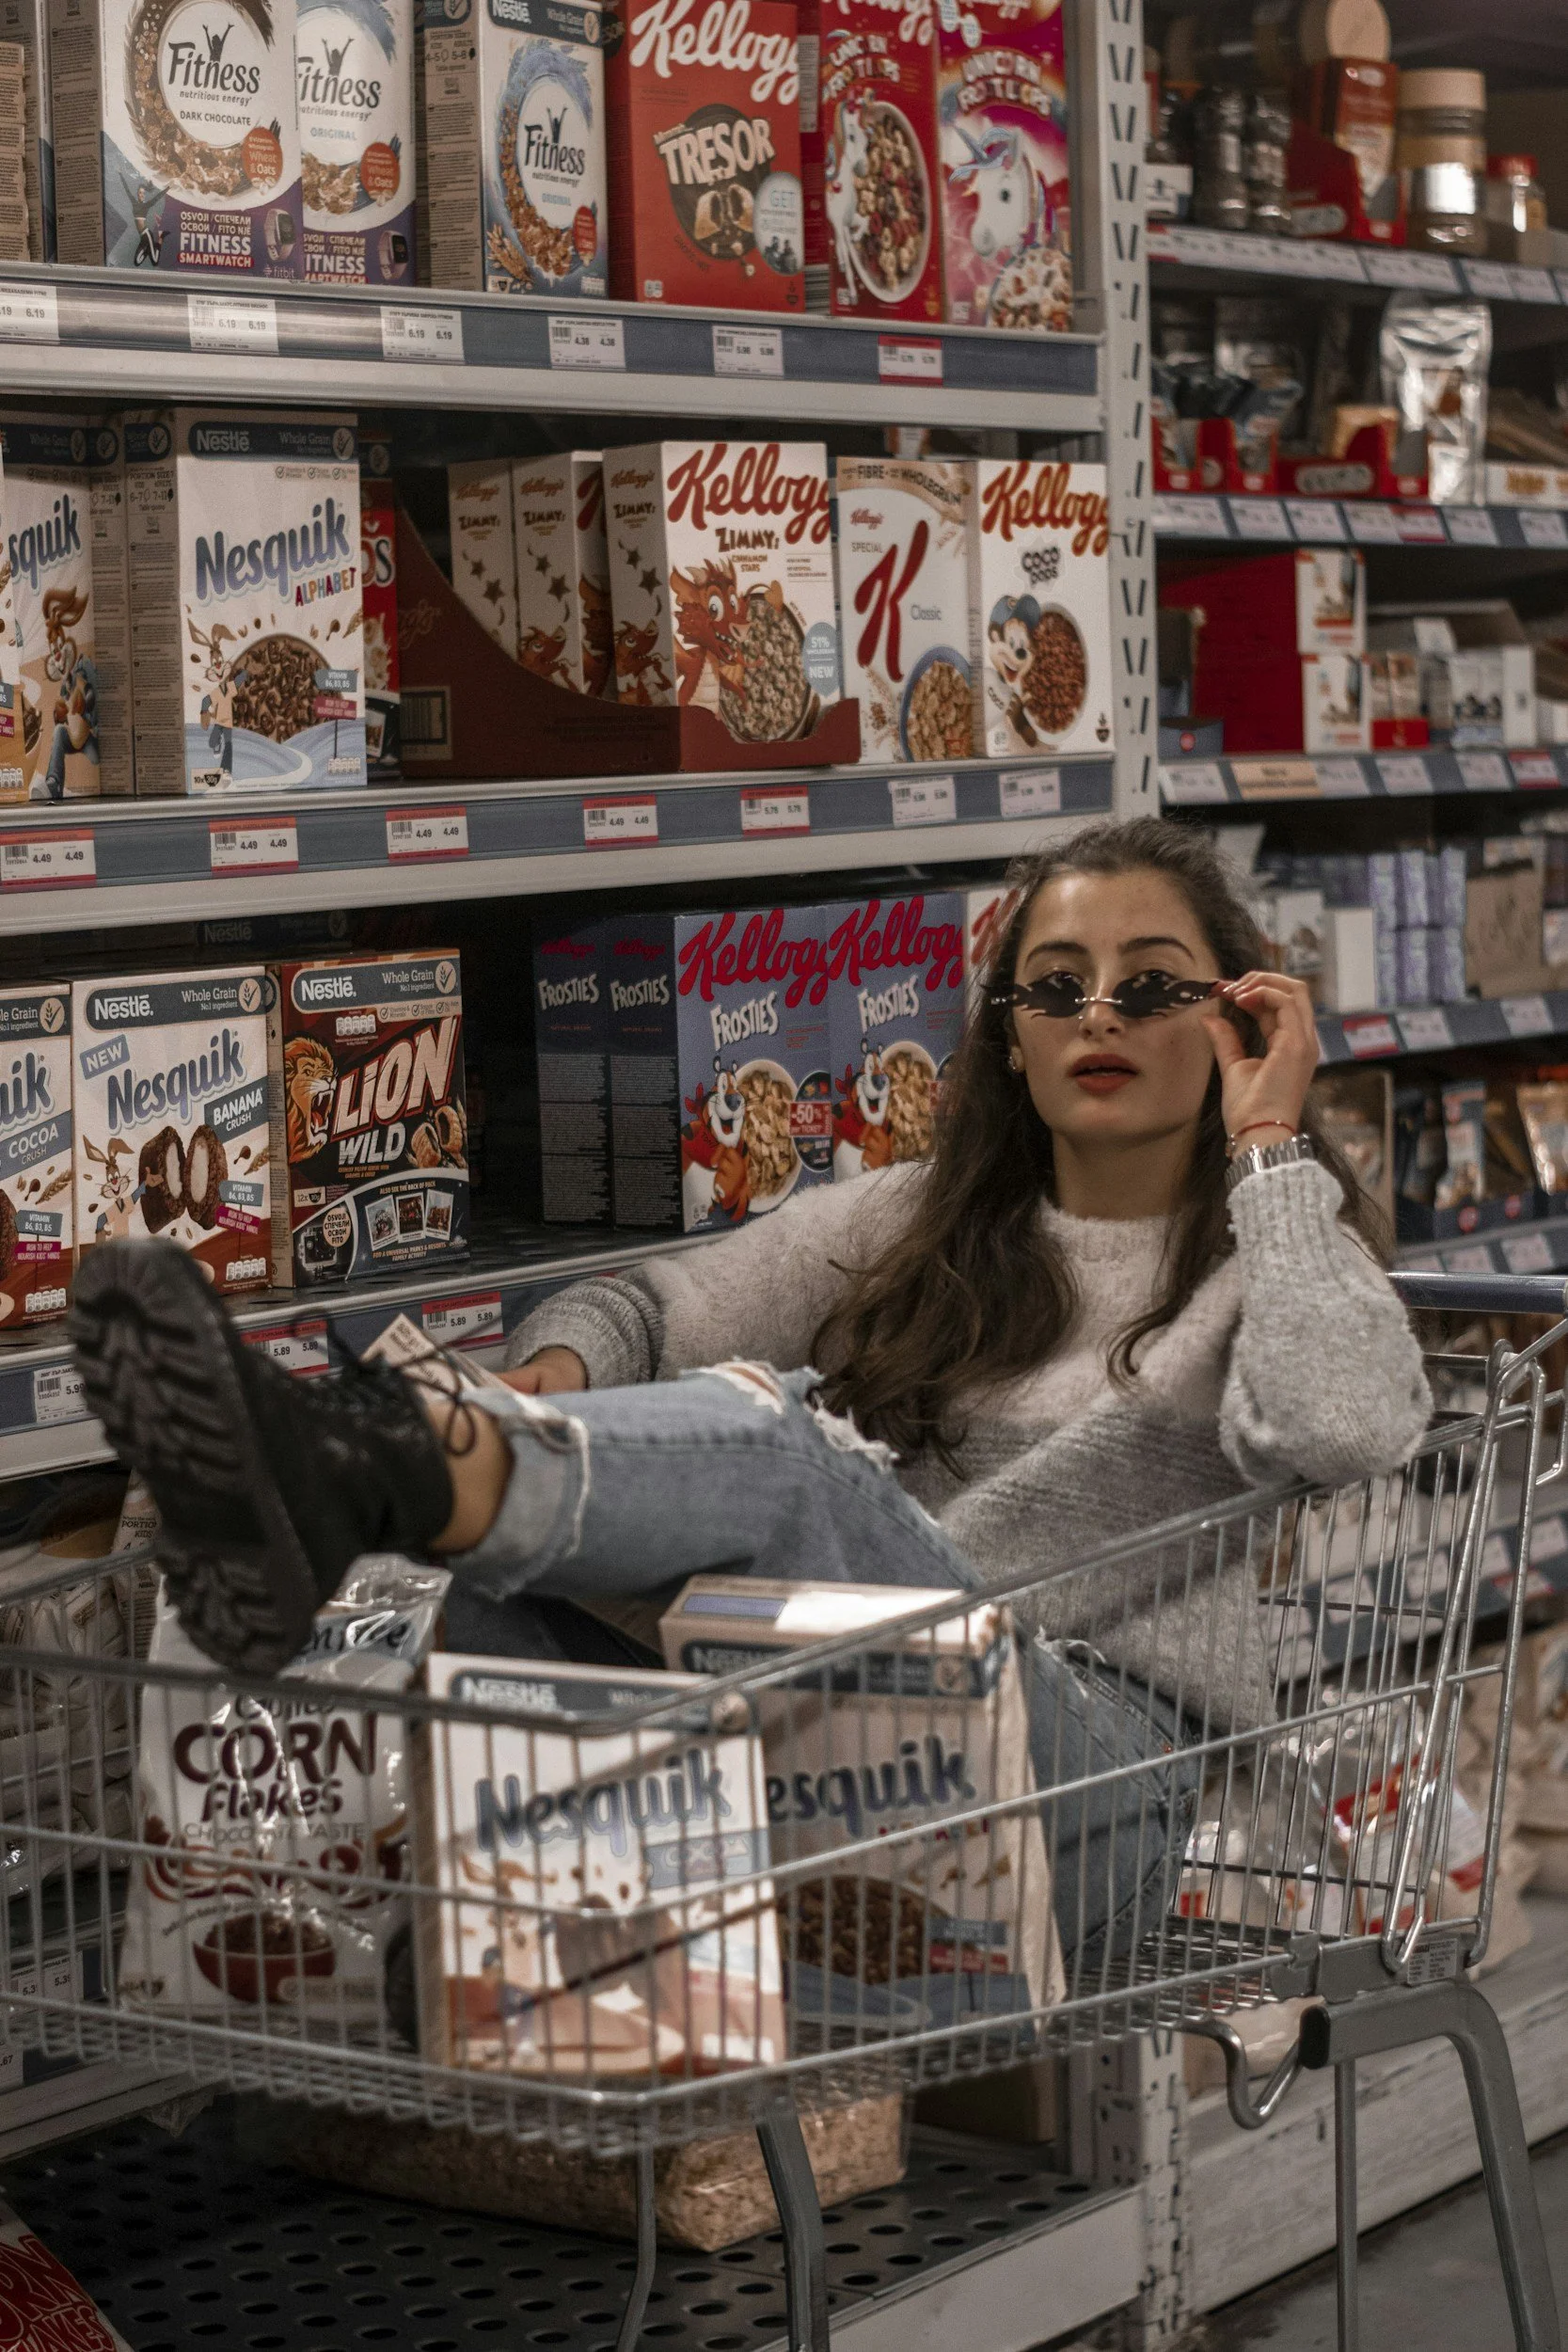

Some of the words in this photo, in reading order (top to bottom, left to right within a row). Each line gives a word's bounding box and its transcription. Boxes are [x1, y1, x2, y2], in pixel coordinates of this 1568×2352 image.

[168, 42, 260, 93] Fitness
[180, 91, 219, 102] nutritious
[180, 111, 202, 120] DARK
[204, 114, 251, 125] CHOCOLATE
[525, 124, 585, 176] Fitness
[659, 119, 775, 184] TRESOR
[257, 165, 277, 176] Oats
[181, 232, 251, 255] FITNESS
[180, 253, 251, 267] SMARTWATCH
[306, 254, 365, 275] ITNESS
[274, 265, 295, 278] fitbit
[305, 273, 366, 284] ARTWATCH
[26, 307, 45, 318] 6.19
[218, 319, 236, 328] 6.19
[248, 320, 266, 330] 6.19
[436, 330, 452, 341] 6.19
[858, 465, 884, 479] FIBRE
[8, 494, 81, 590] squik
[196, 498, 350, 600] Nesquik
[851, 542, 882, 553] SPECIAL
[295, 567, 356, 607] ALPHABET
[911, 604, 942, 621] Classic
[809, 666, 834, 679] NEW
[610, 817, 625, 827] 4.49
[634, 816, 649, 825] 4.49
[416, 829, 433, 839] 4.49
[443, 827, 459, 836] 4.49
[240, 840, 258, 850] 4.49
[270, 838, 287, 849] 4.49
[33, 853, 52, 864] 4.49
[65, 850, 84, 862] 4.49
[382, 972, 409, 984] Whole
[411, 970, 434, 981] Grain
[182, 989, 211, 1003] Whole
[213, 988, 237, 1000] Grain
[537, 974, 600, 1010] FROSTIES
[610, 974, 670, 1011] FROSTIES
[212, 1001, 238, 1011] ingredient
[857, 974, 920, 1033] FROSTIES
[11, 1008, 39, 1021] Grain
[710, 991, 779, 1052] FROSTIES
[10, 1022, 39, 1032] ingredient
[86, 1042, 122, 1072] NEW
[107, 1028, 244, 1129] Nesquik
[333, 1016, 457, 1135] LION
[213, 1092, 263, 1125] BANANA
[226, 1112, 252, 1131] CRUSH
[8, 1122, 59, 1158] COCOA
[339, 1122, 405, 1165] WILD
[21, 1148, 47, 1165] CRUSH
[29, 1214, 50, 1222] VITAMIN
[451, 1316, 467, 1327] 5.89
[477, 1311, 493, 1322] 5.89
[274, 1345, 291, 1357] 5.89
[302, 1341, 318, 1352] 5.89
[174, 1711, 376, 1785] CORN
[765, 1735, 976, 1838] esquik
[475, 1747, 732, 1858] Nesquik
